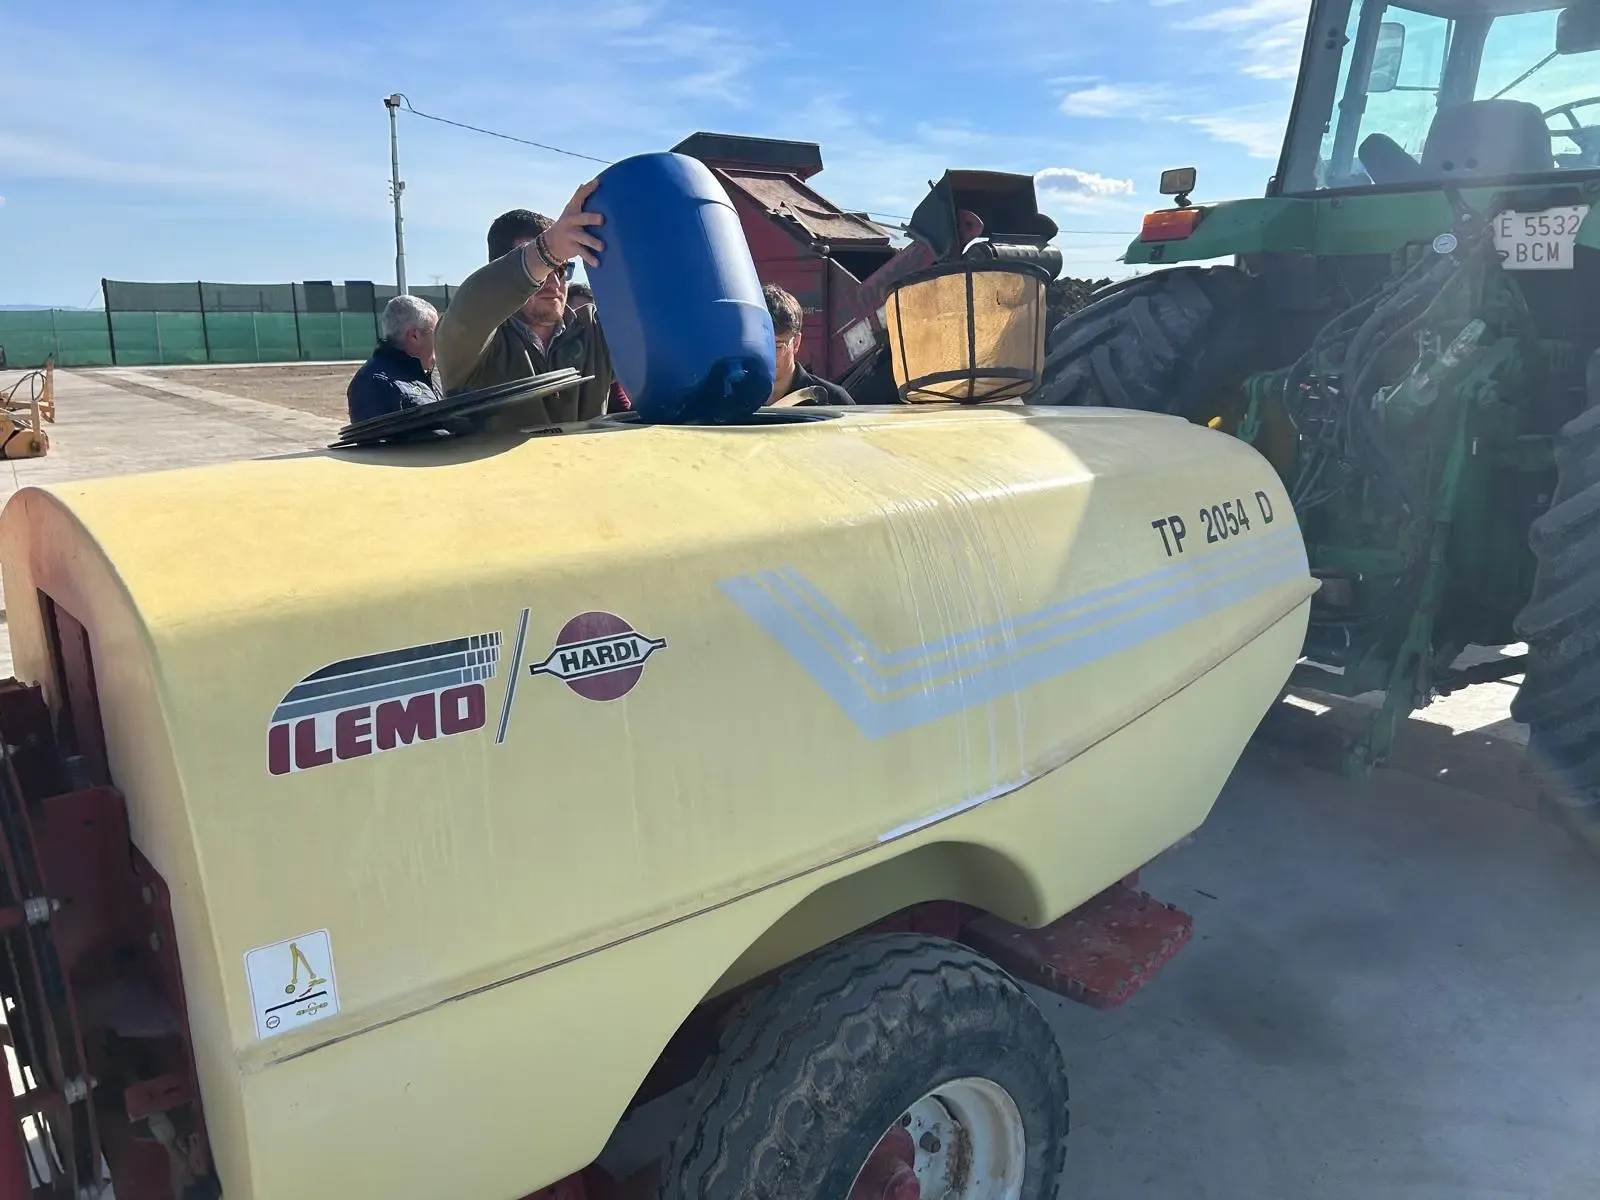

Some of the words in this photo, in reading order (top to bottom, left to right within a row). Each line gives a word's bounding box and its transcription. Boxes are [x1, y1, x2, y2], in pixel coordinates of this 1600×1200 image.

[1501, 217, 1513, 238] E
[1525, 215, 1579, 237] 5532
[1516, 242, 1560, 263] BCM
[1151, 515, 1187, 557] TP
[1200, 498, 1251, 544] 2054
[1254, 490, 1274, 525] D
[559, 639, 641, 673] HARDI
[268, 683, 487, 776] ILEMO
